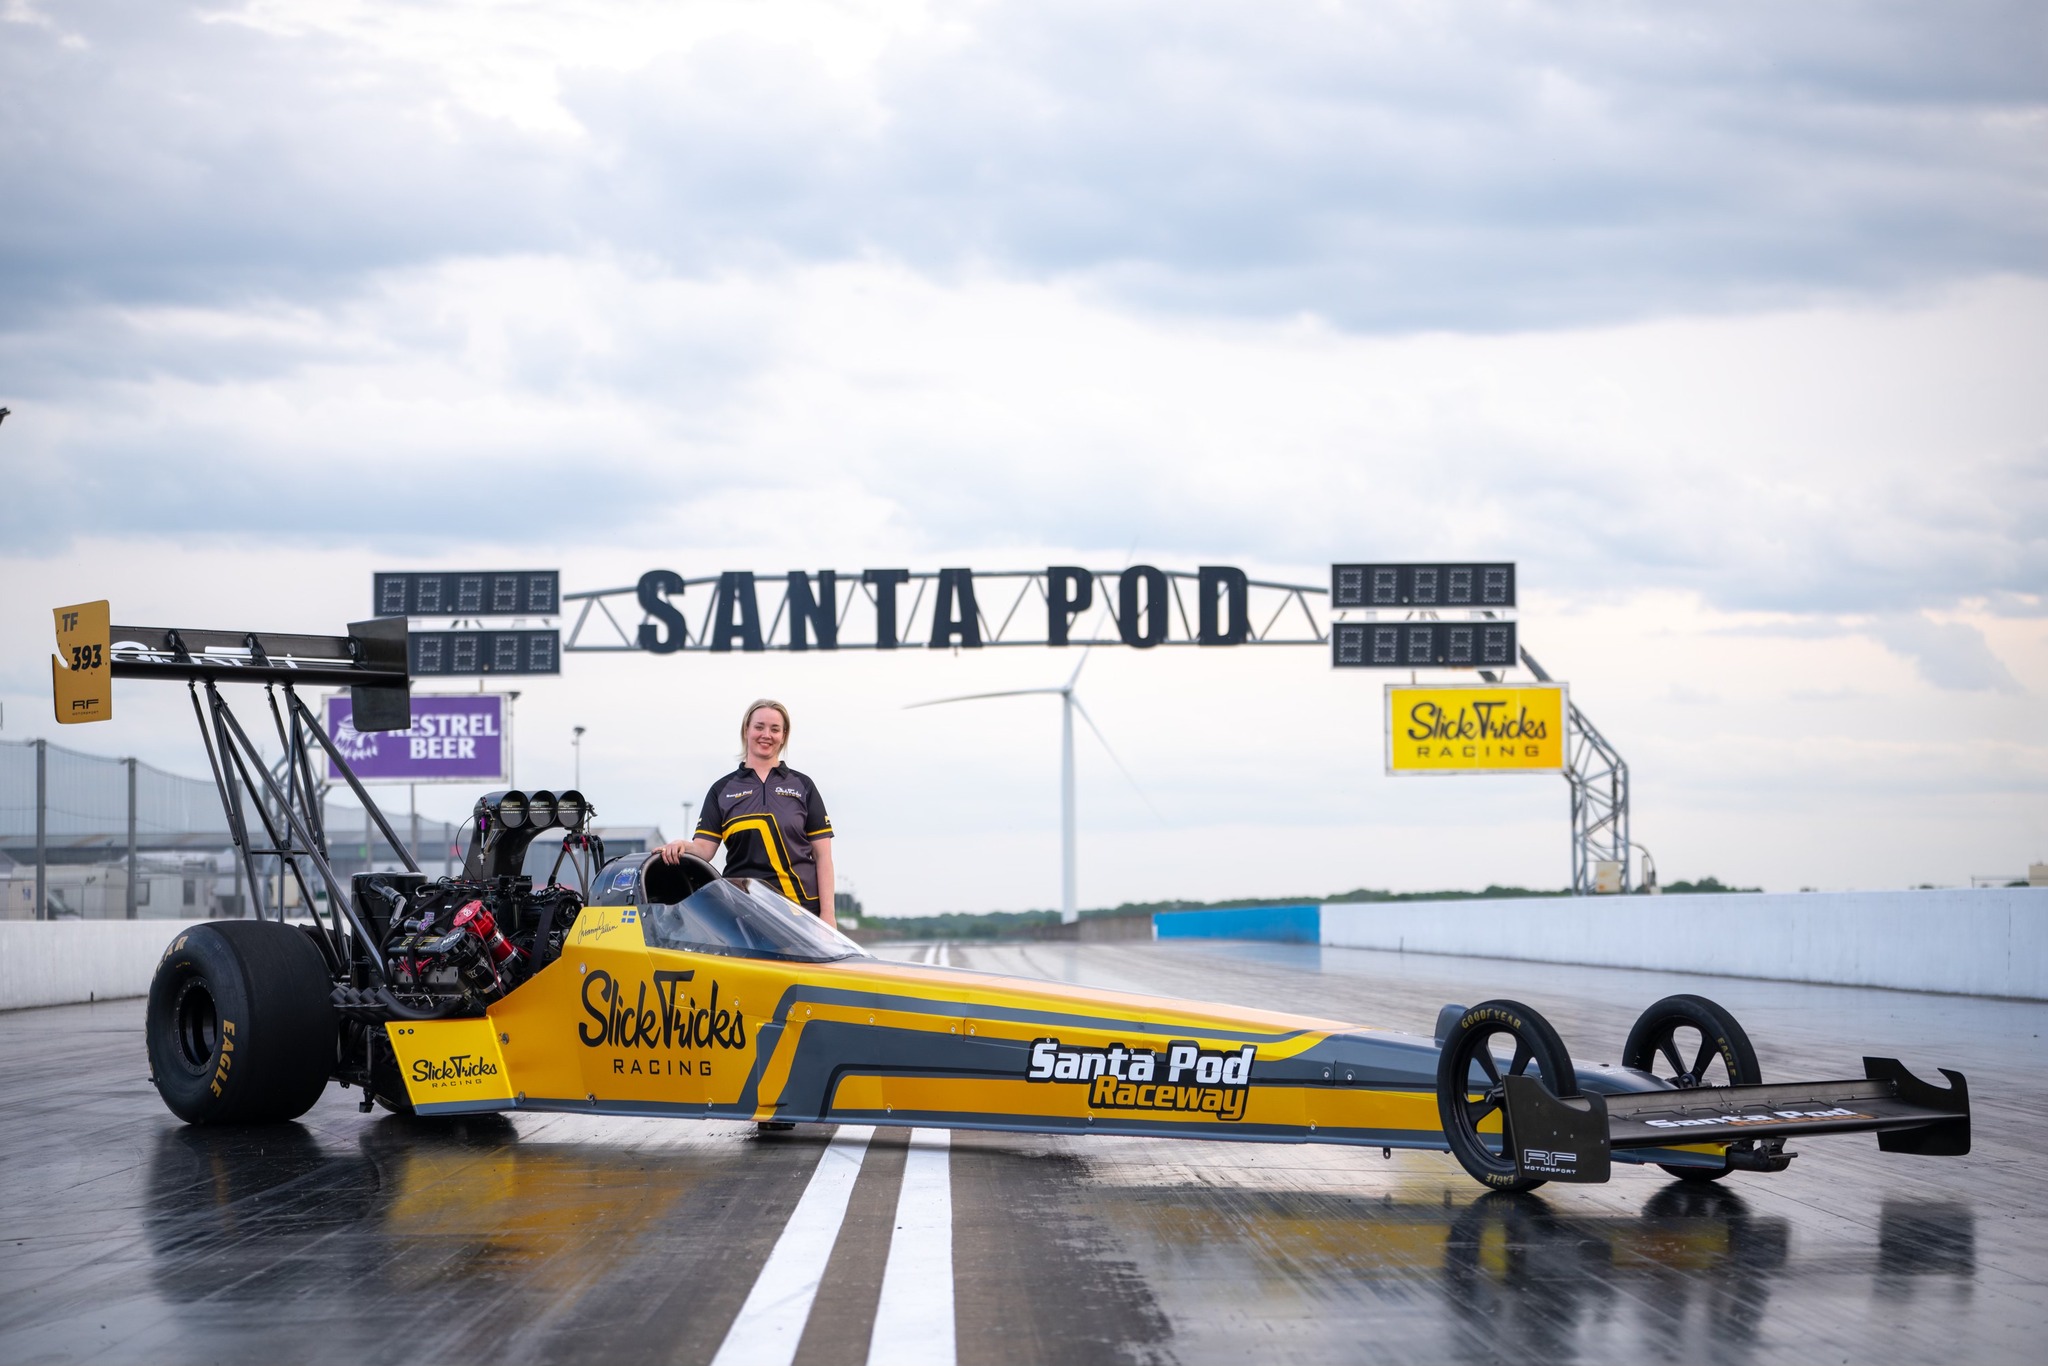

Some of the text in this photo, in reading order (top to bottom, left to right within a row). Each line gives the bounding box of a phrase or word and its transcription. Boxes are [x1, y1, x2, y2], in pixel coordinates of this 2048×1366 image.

[637, 567, 983, 655] SANTA
[1047, 565, 1249, 648] POD
[62, 612, 78, 632] TF
[70, 644, 102, 671] 393
[73, 699, 99, 710] RF
[409, 738, 476, 759] BEER
[1417, 745, 1540, 758] RACING
[210, 1019, 235, 1098] EAGLE
[613, 1058, 712, 1076] RACING
[1029, 1042, 1255, 1085] Santa Pod
[1717, 1037, 1737, 1077] EAGLE
[431, 1079, 482, 1088] RACING
[1092, 1074, 1246, 1119] Raceway
[1773, 1107, 1858, 1119] Pod
[1524, 1149, 1577, 1166] RF
[1524, 1165, 1577, 1174] MOTORSPORT
